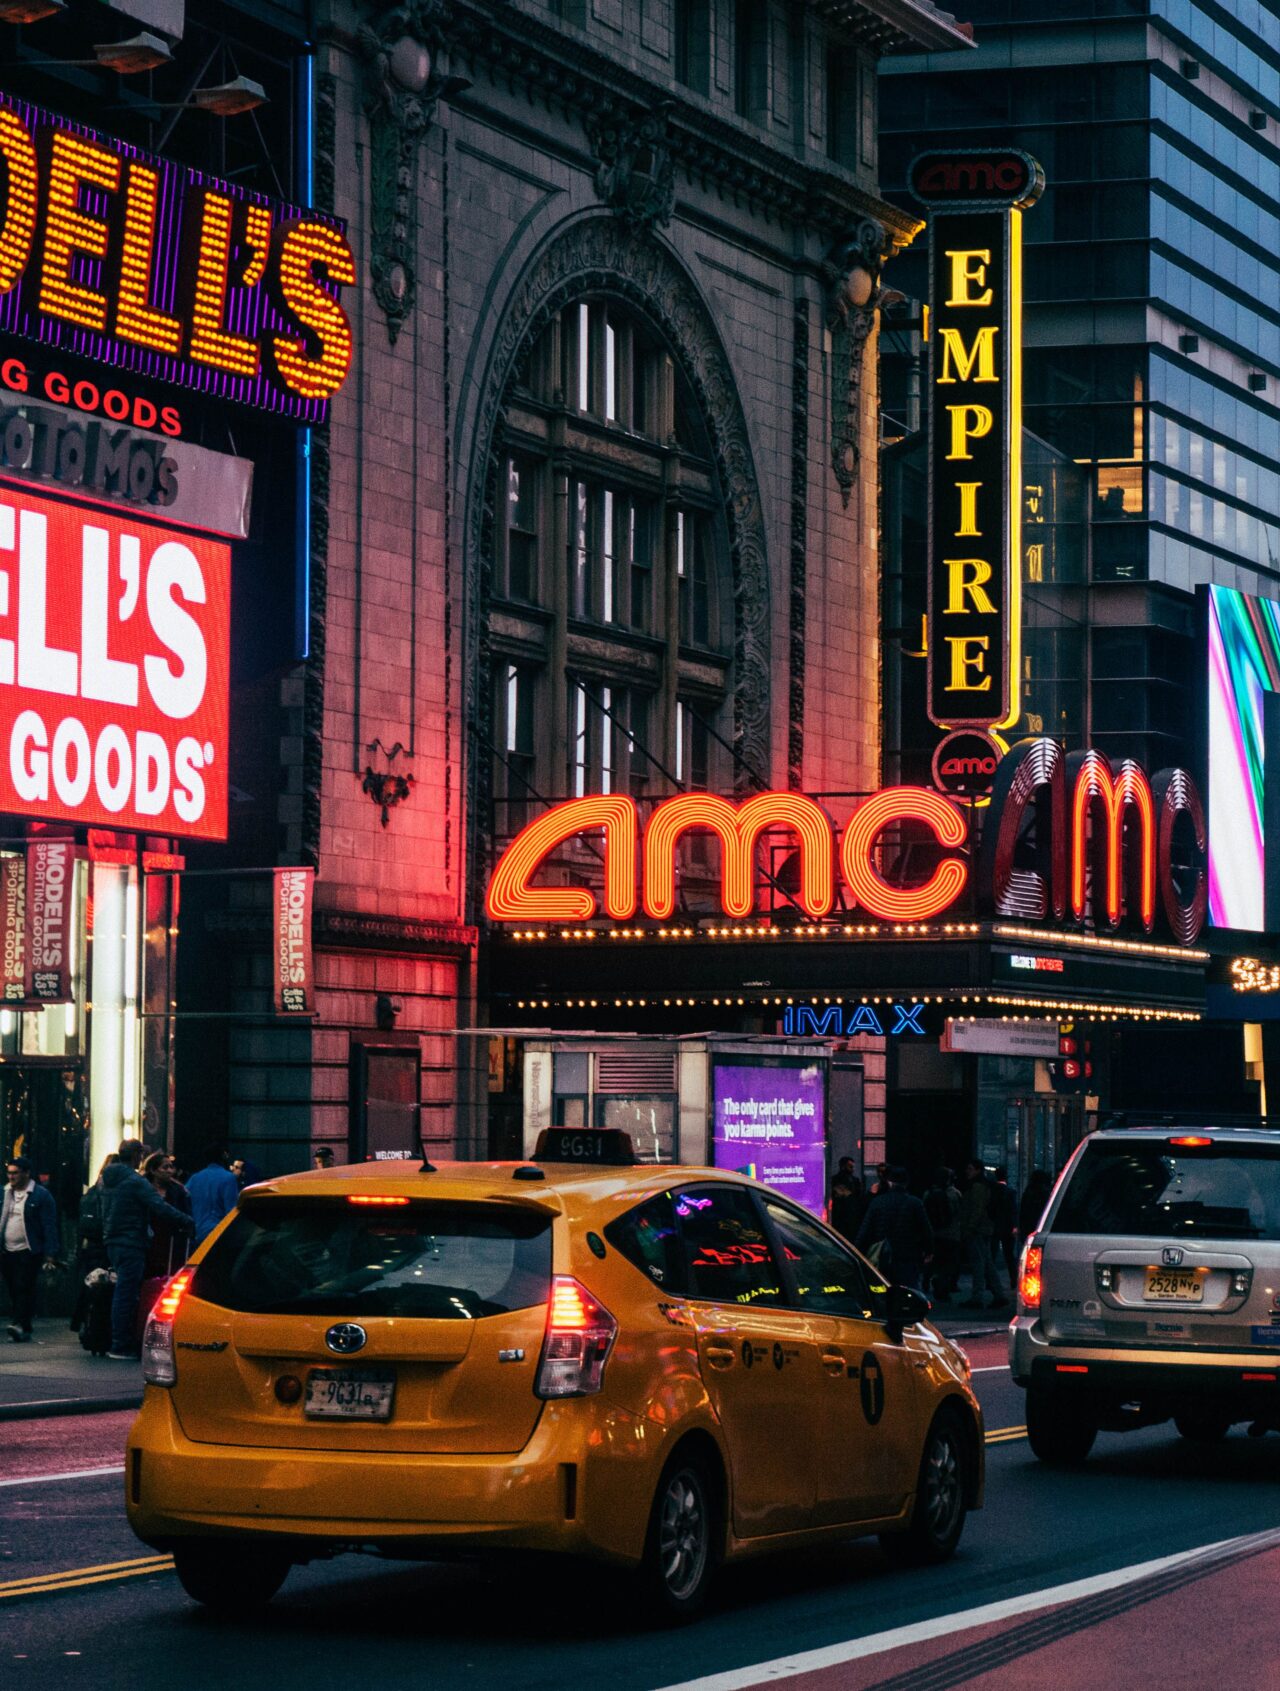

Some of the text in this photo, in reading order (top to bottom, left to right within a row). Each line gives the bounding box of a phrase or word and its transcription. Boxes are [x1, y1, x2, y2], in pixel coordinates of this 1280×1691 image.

[44, 372, 182, 436] GOODS
[937, 250, 999, 691] EMPIRE
[32, 843, 47, 913] SPORTING
[486, 786, 968, 922] amc
[6, 861, 17, 927] SPORTING
[43, 843, 66, 967] MODELL'S
[280, 872, 291, 934] SPORTING
[288, 871, 307, 983] MODELL'S
[784, 1004, 927, 1035] IMAX
[723, 1098, 814, 1119] The only card that gives
[723, 1120, 794, 1141] you karma points.
[375, 1150, 403, 1160] WELCOME
